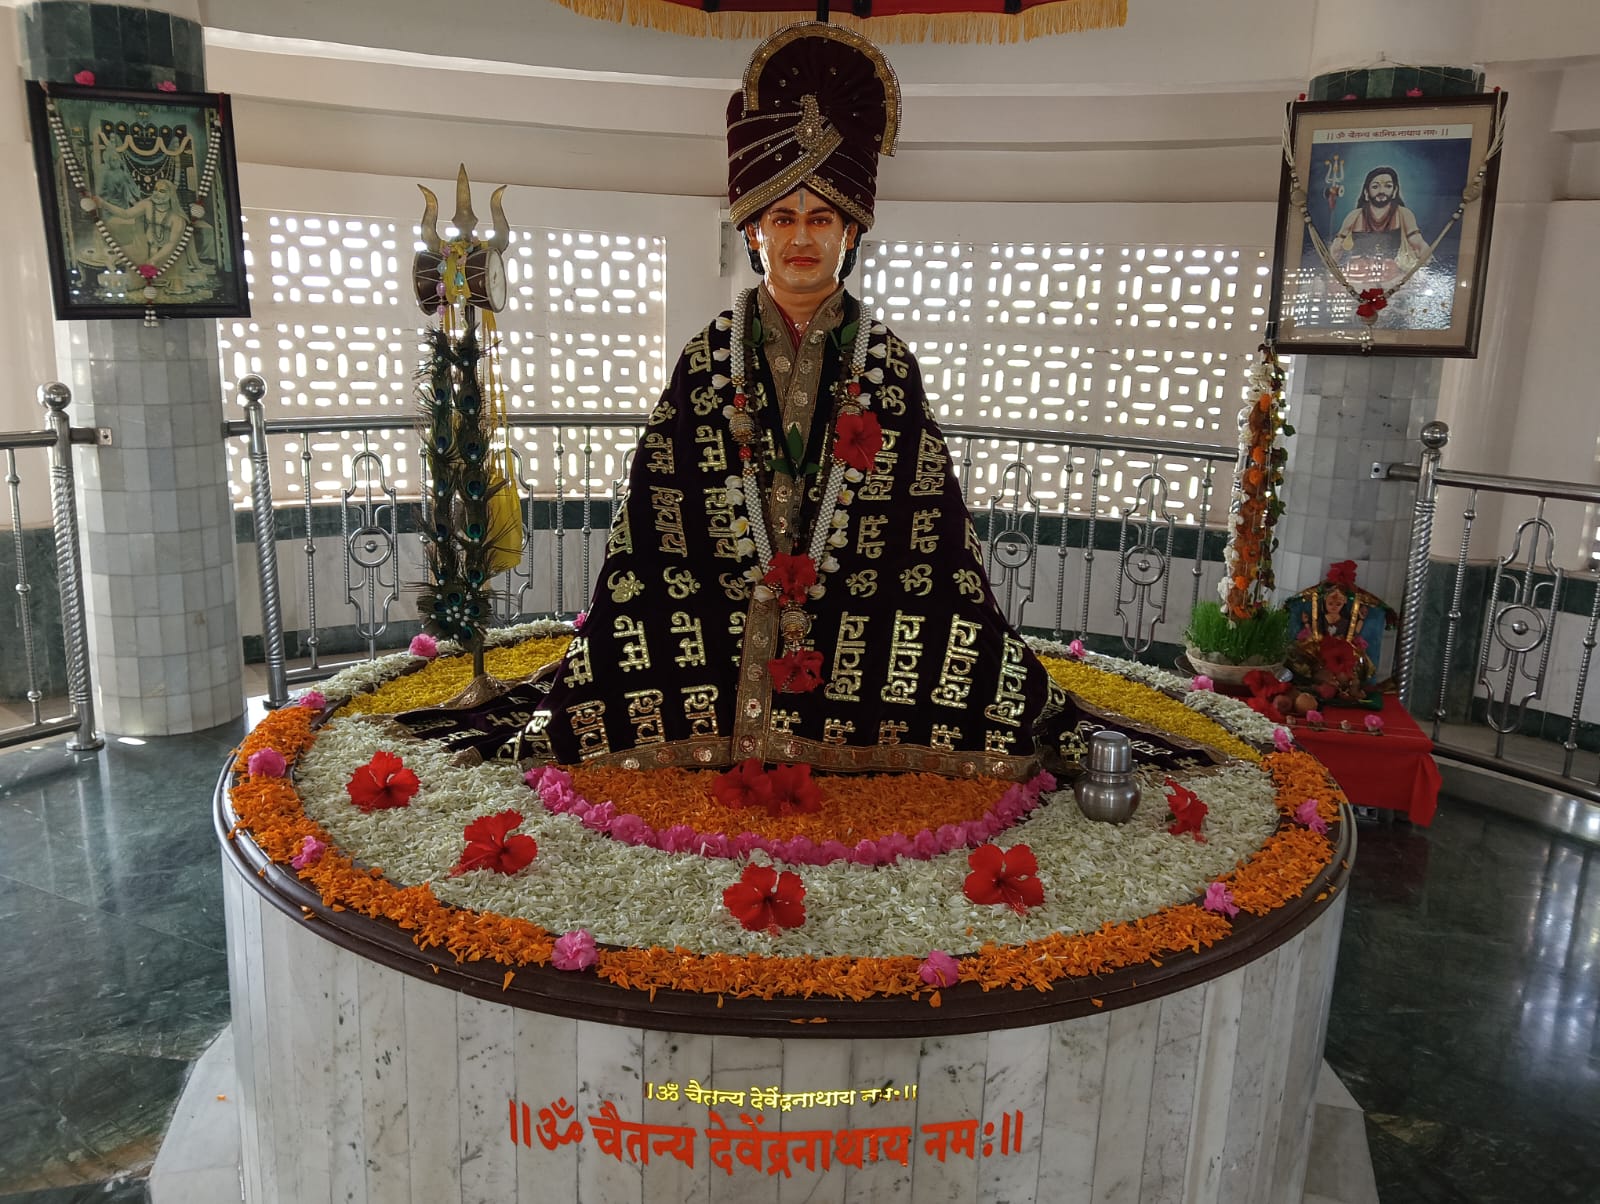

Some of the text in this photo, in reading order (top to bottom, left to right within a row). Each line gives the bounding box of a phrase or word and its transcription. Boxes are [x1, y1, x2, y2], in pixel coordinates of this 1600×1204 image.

[649, 400, 677, 427] ॐ
[690, 385, 723, 416] ॐ
[874, 385, 907, 416] ॐ
[649, 485, 688, 558] शिवाय
[607, 570, 646, 603] ॐ
[663, 566, 702, 600] ॐ
[845, 569, 878, 598] ॐ
[900, 564, 933, 596] ॐ
[952, 568, 985, 604] ॐ
[824, 611, 870, 702] शिवाय
[880, 609, 926, 705] शिवाय
[930, 613, 983, 710] शिवाय
[984, 631, 1028, 727] शिवाय
[684, 1079, 745, 1107] चैतन्य
[750, 1086, 857, 1112] देवेंद्रनाथाय
[588, 1100, 697, 1170] चैतन्य
[704, 1110, 912, 1180] देवेंद्रनाथाय
